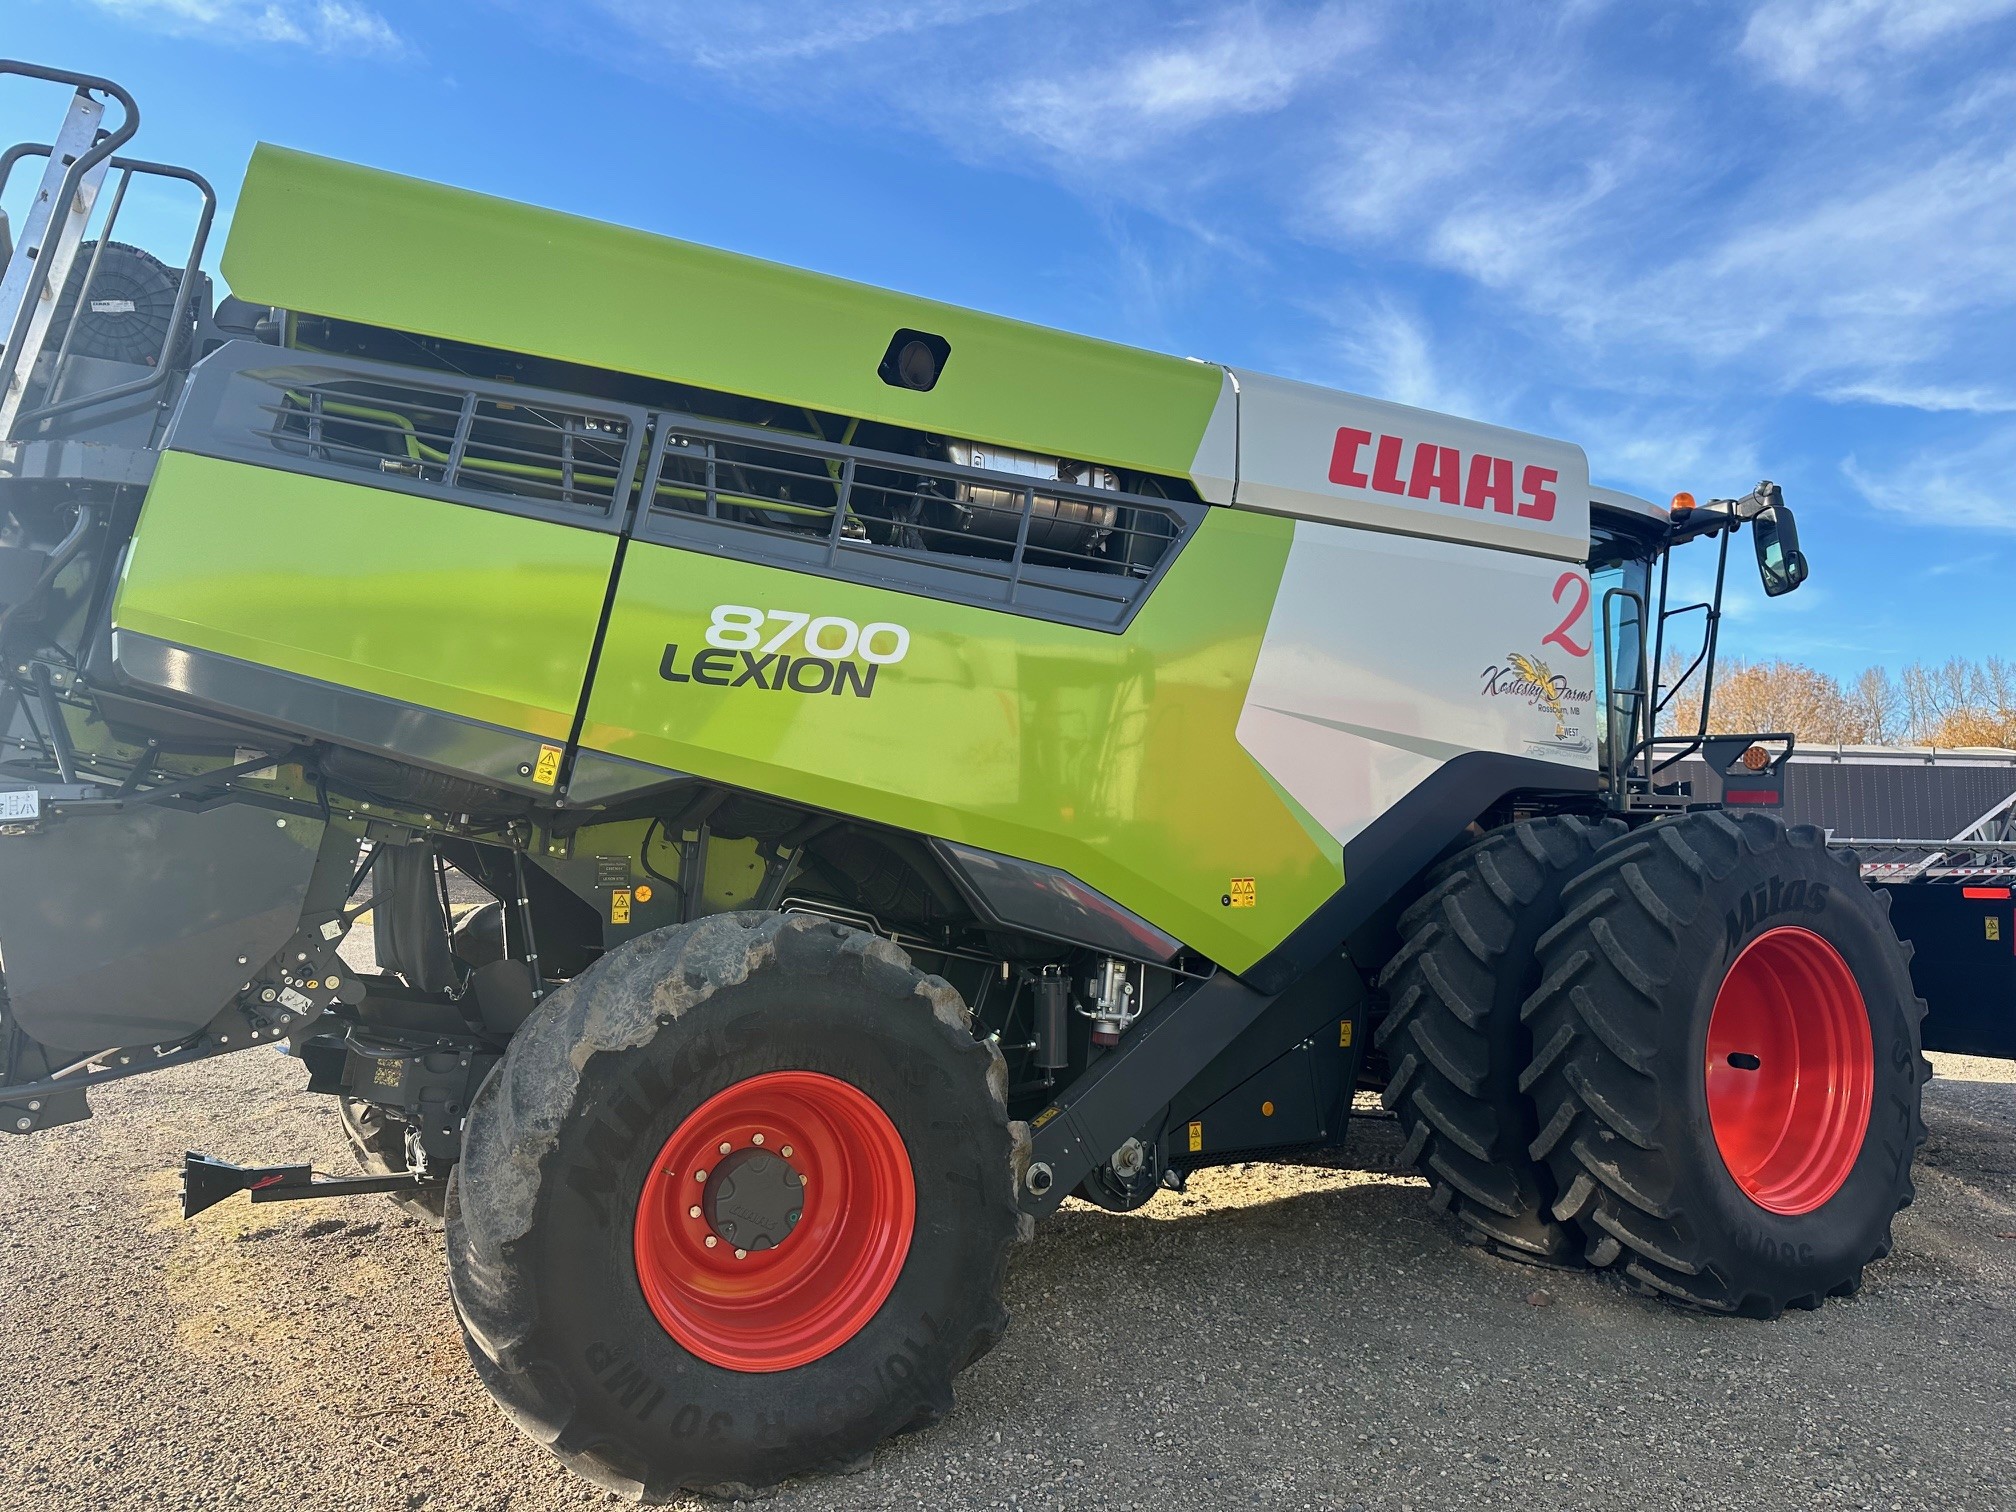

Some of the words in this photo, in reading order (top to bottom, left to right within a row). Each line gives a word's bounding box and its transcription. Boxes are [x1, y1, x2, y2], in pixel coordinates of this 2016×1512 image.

[1328, 426, 1558, 522] CLAAS
[705, 604, 911, 664] 8700
[1541, 571, 1592, 658] 2
[658, 643, 879, 698] LEXION
[1546, 674, 1594, 702] Farms
[1570, 706, 1580, 716] MB
[1722, 874, 1830, 966] Mitas
[566, 1010, 769, 1230] Mitas
[584, 1340, 667, 1422] IMP
[669, 1403, 734, 1443] 30
